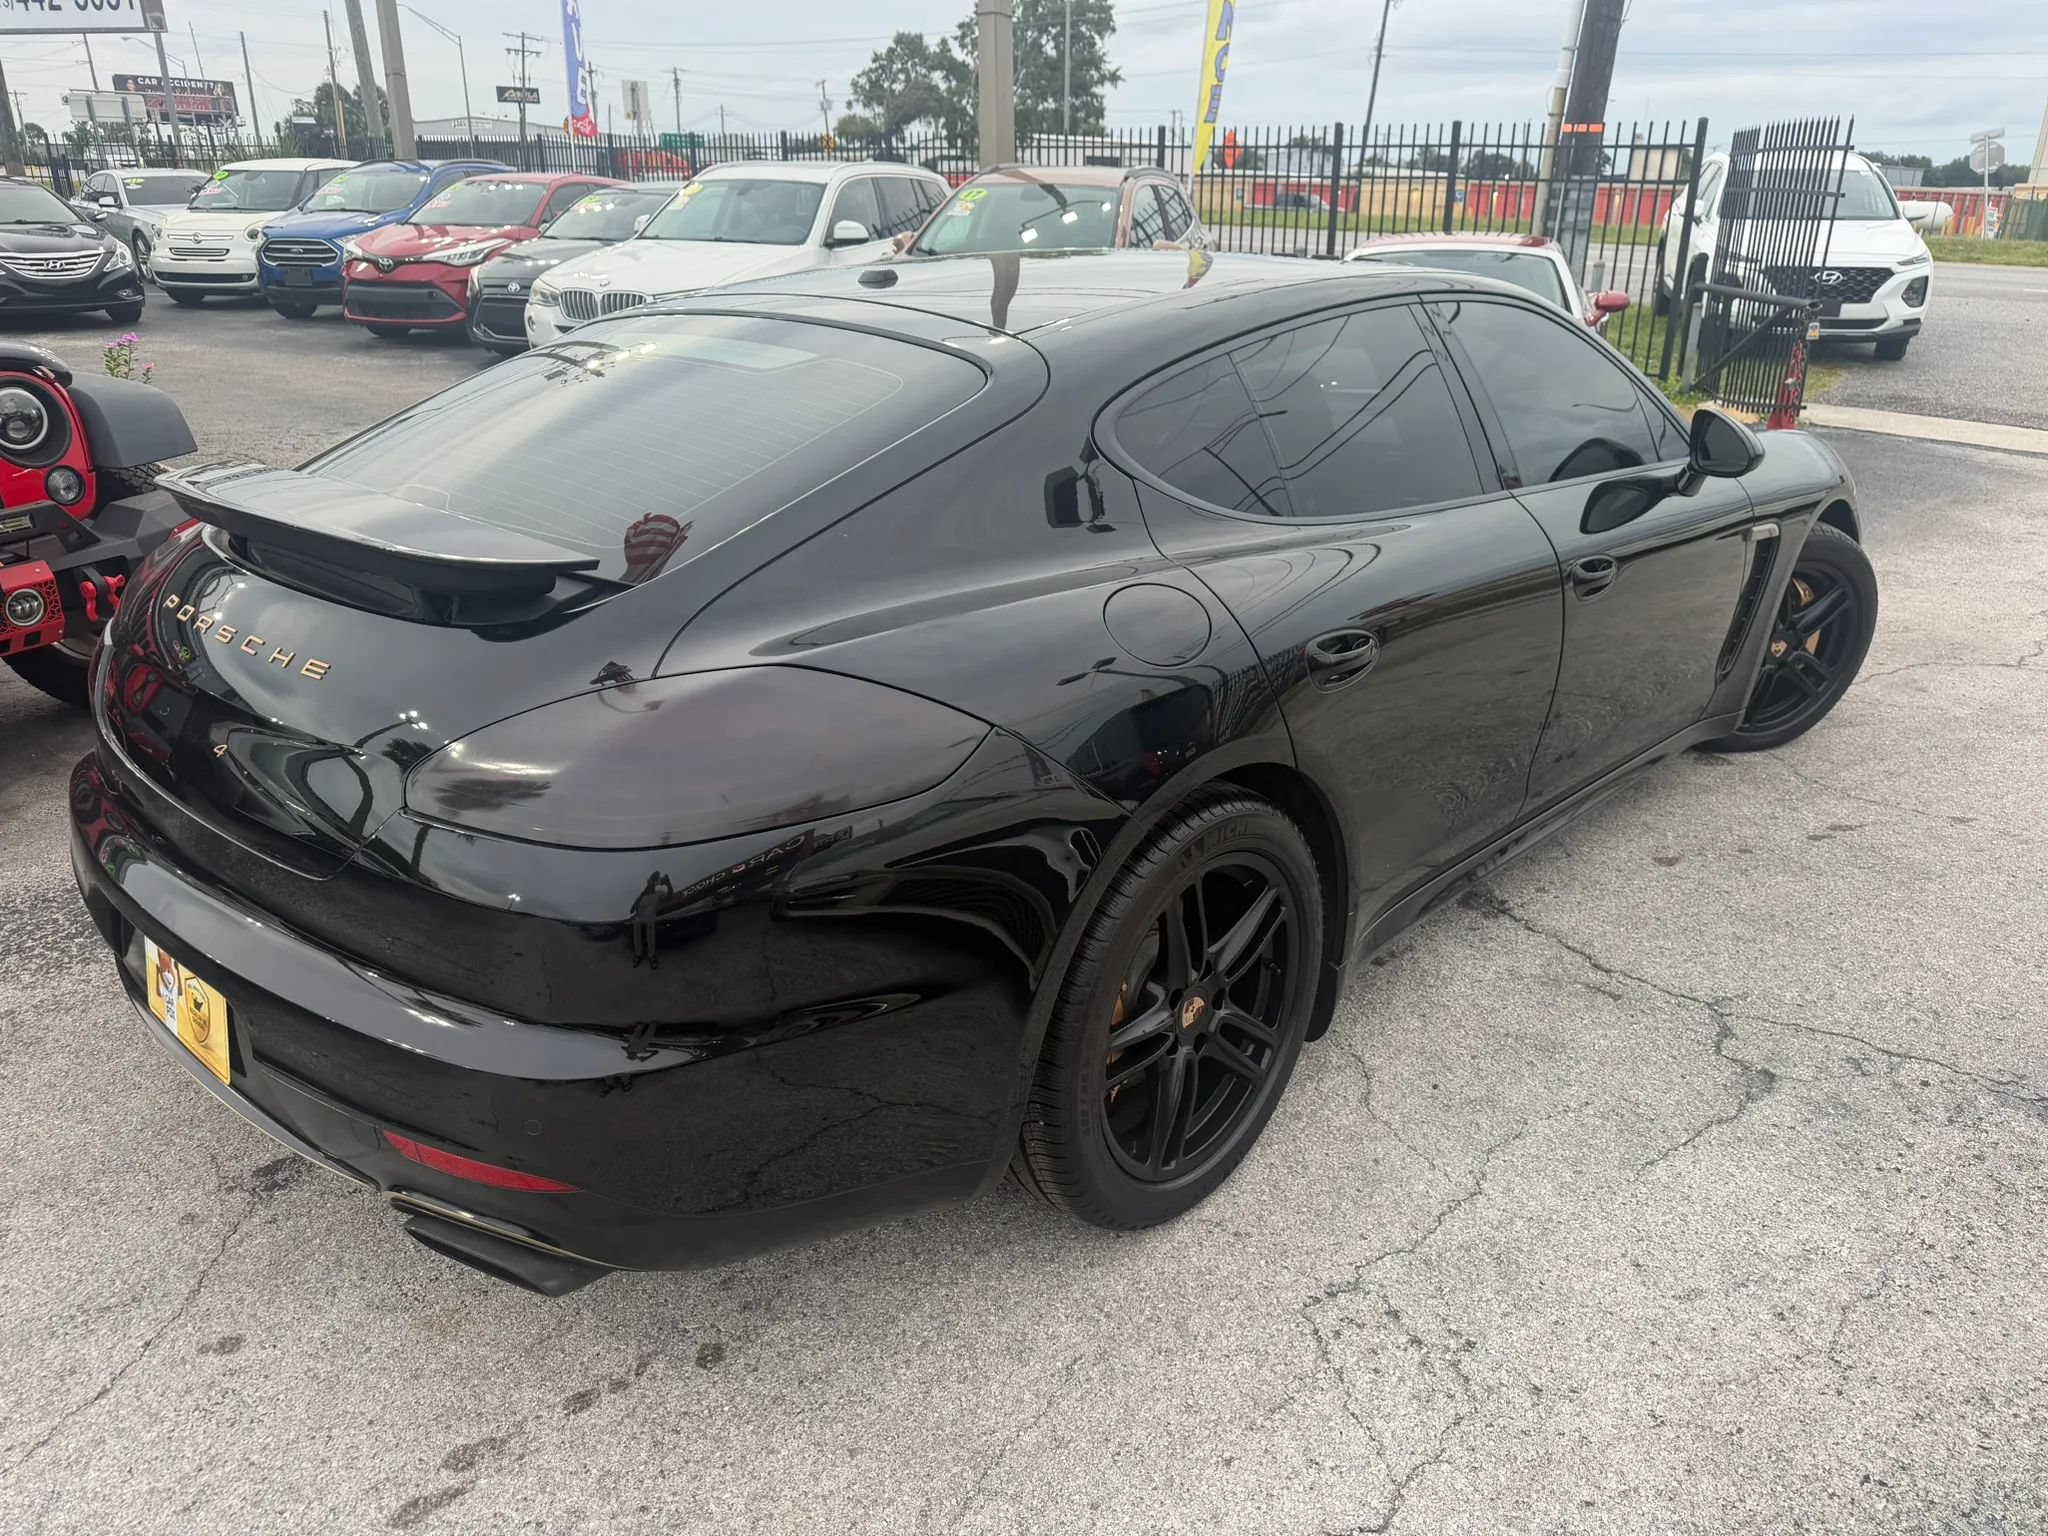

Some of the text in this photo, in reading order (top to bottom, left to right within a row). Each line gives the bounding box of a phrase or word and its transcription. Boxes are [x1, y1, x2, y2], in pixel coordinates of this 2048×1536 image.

[137, 77, 215, 89] CAR CCIDENT?
[163, 593, 332, 680] PORSCHE
[213, 744, 228, 758] 4
